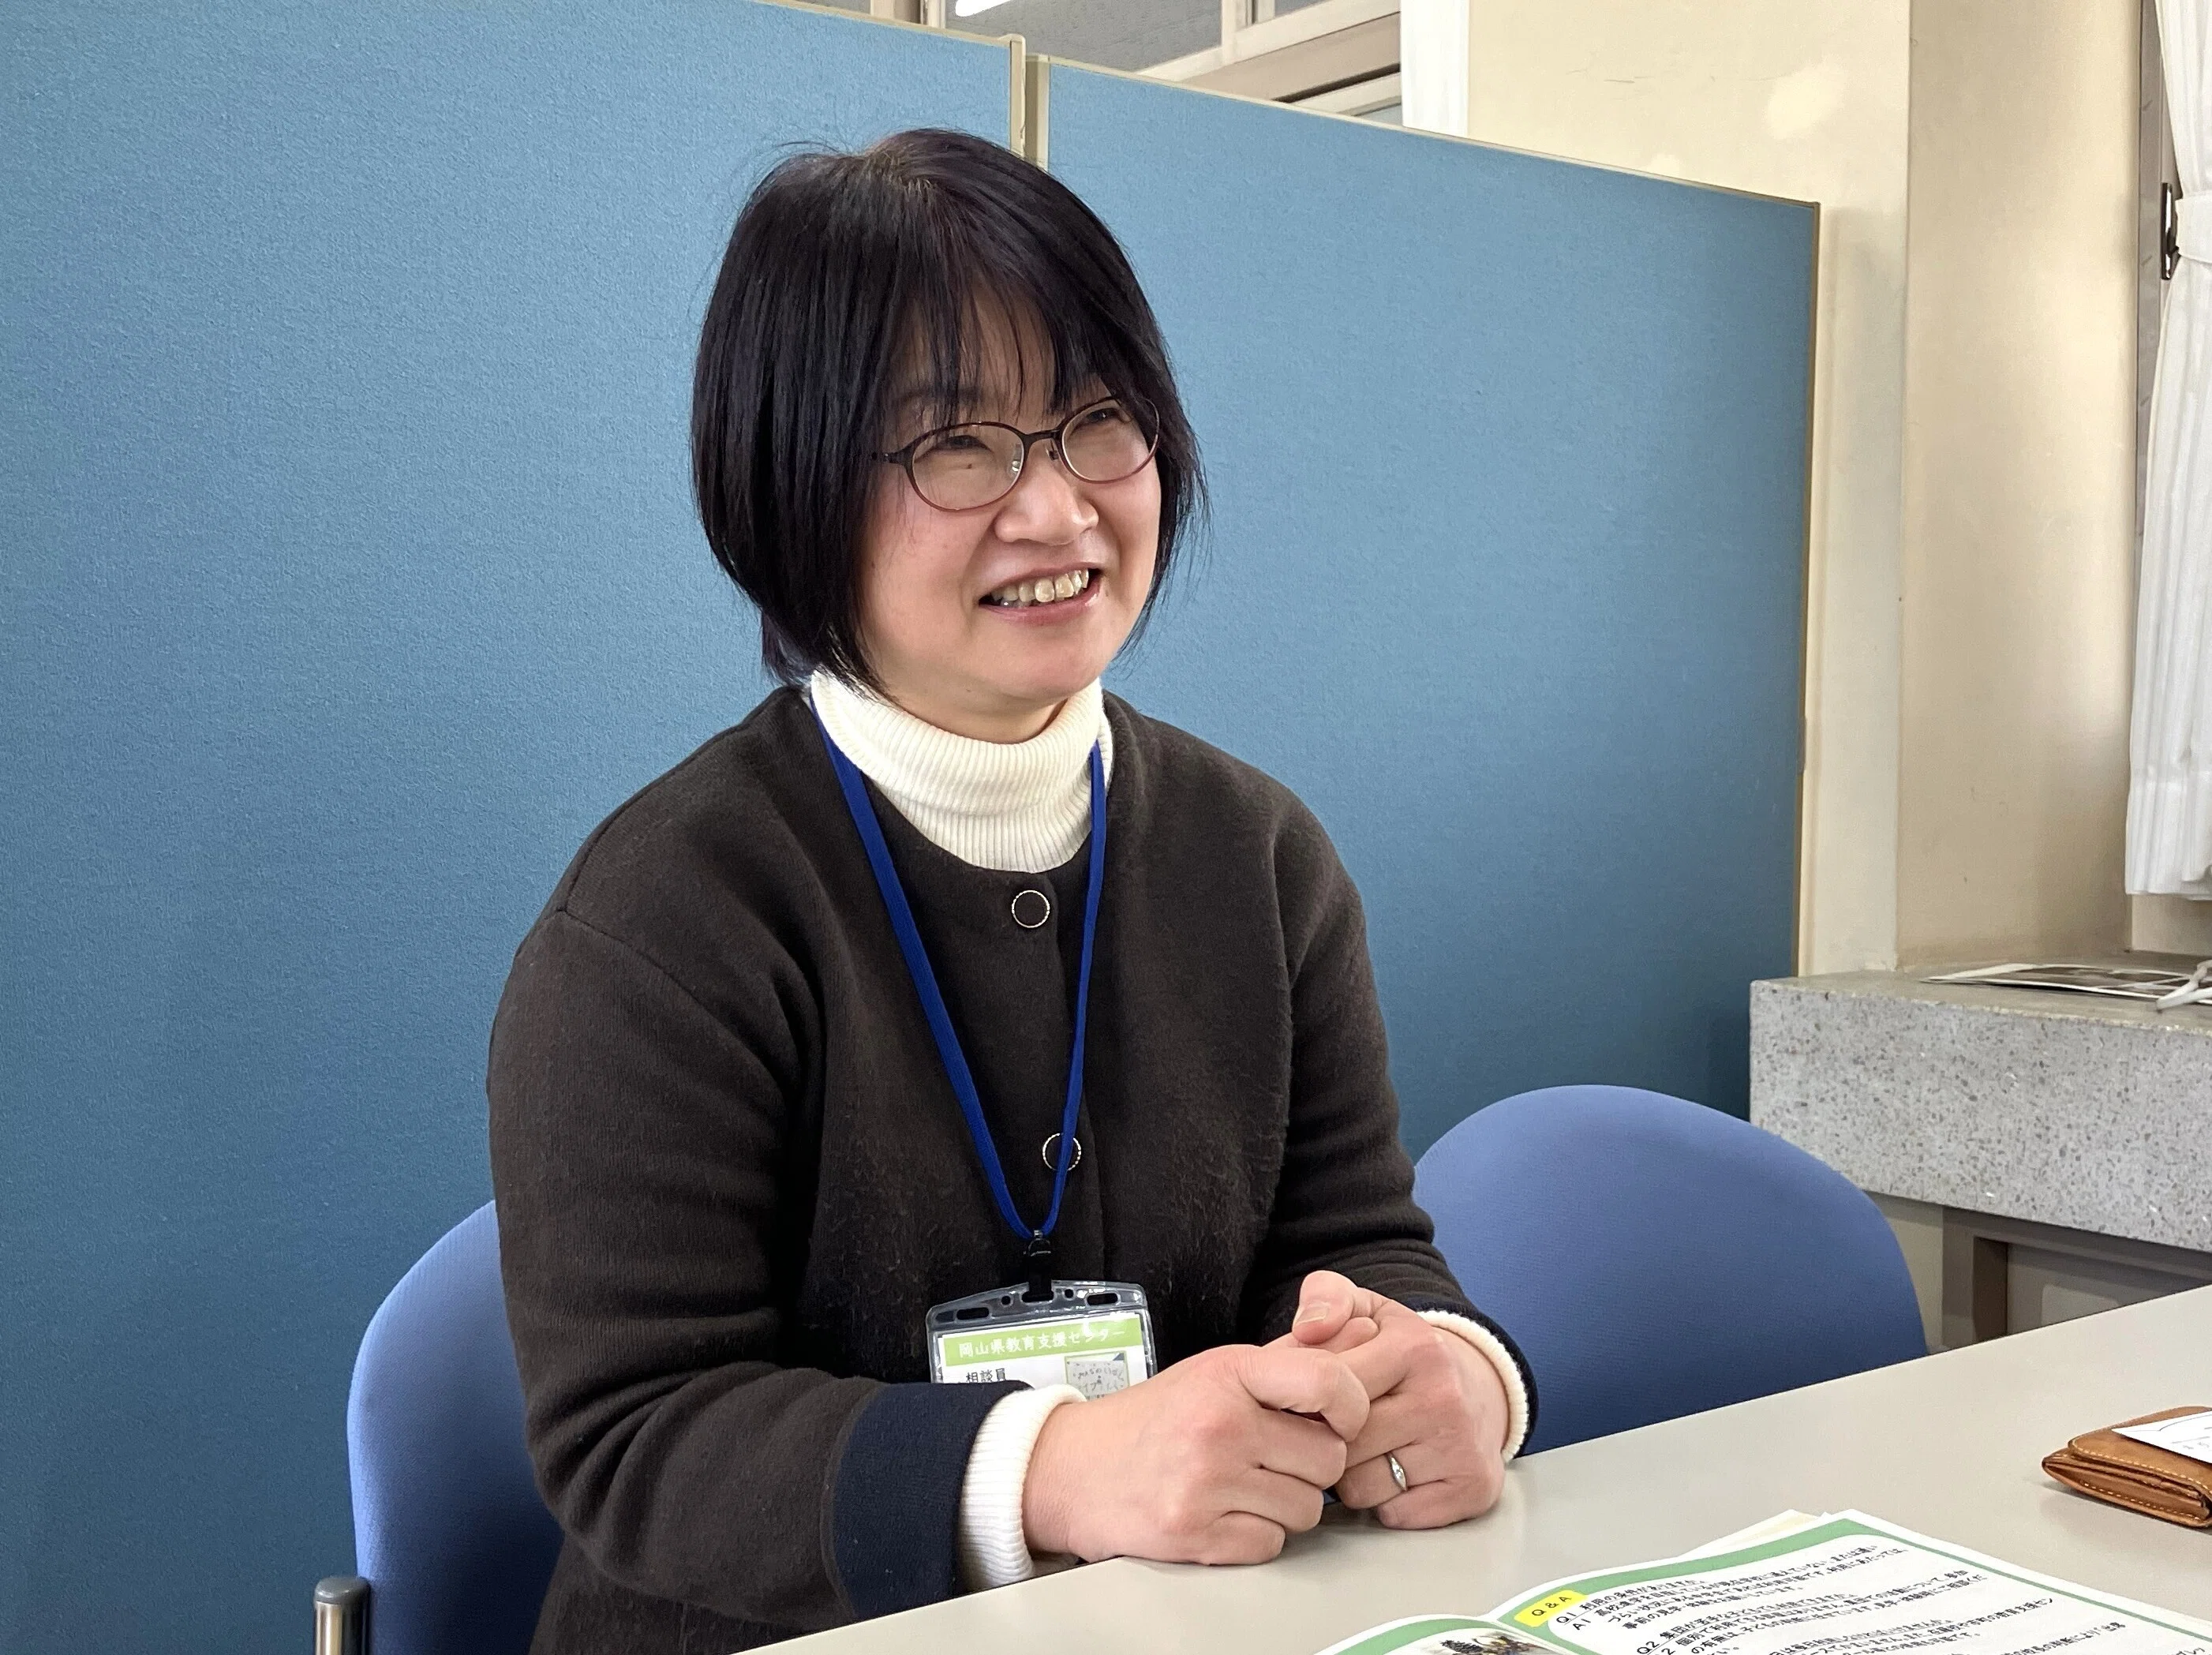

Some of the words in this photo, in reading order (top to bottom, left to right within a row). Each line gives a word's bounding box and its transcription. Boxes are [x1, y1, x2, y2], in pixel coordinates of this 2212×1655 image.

[959, 1329, 1125, 1358] 岡山県教育支援センター
